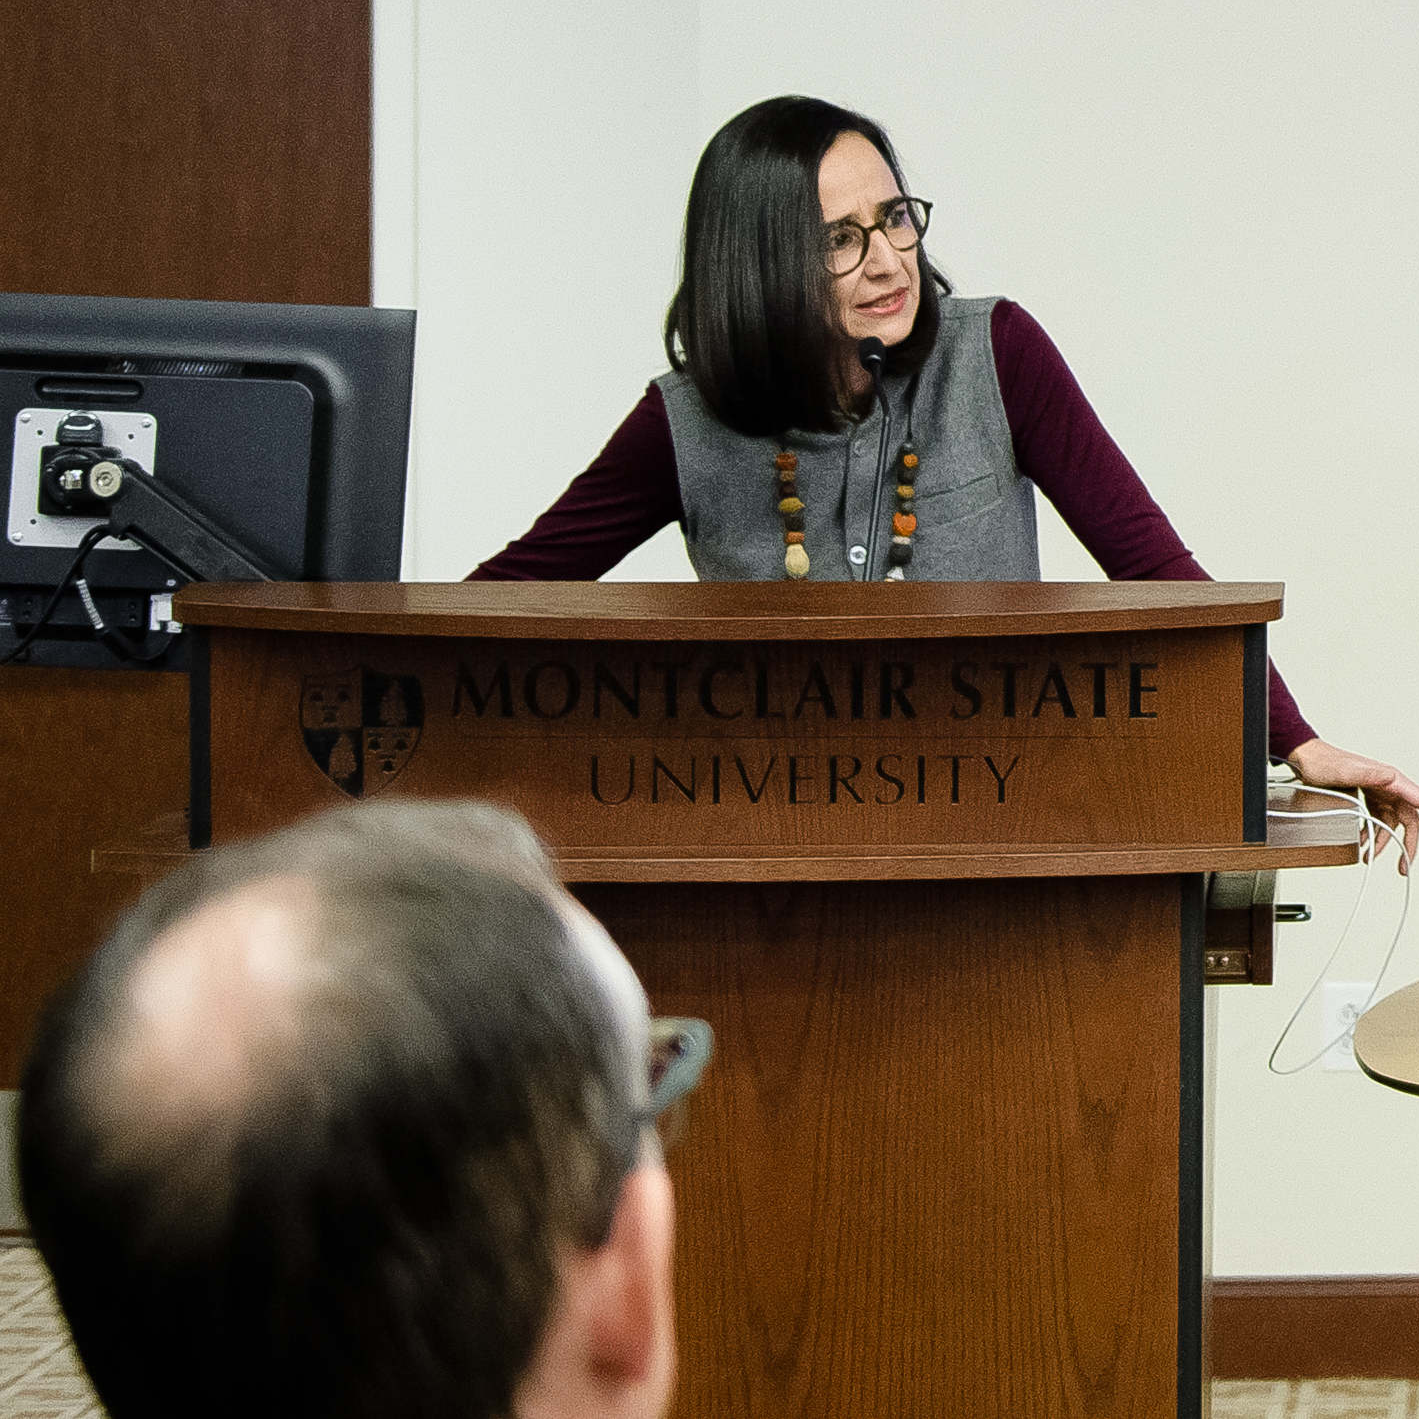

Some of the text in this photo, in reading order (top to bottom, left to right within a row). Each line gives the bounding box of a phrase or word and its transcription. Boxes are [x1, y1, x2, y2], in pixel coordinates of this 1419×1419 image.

[450, 656, 1160, 722] MONTCLAIR STATE
[588, 752, 1022, 808] UNIVERSITY
